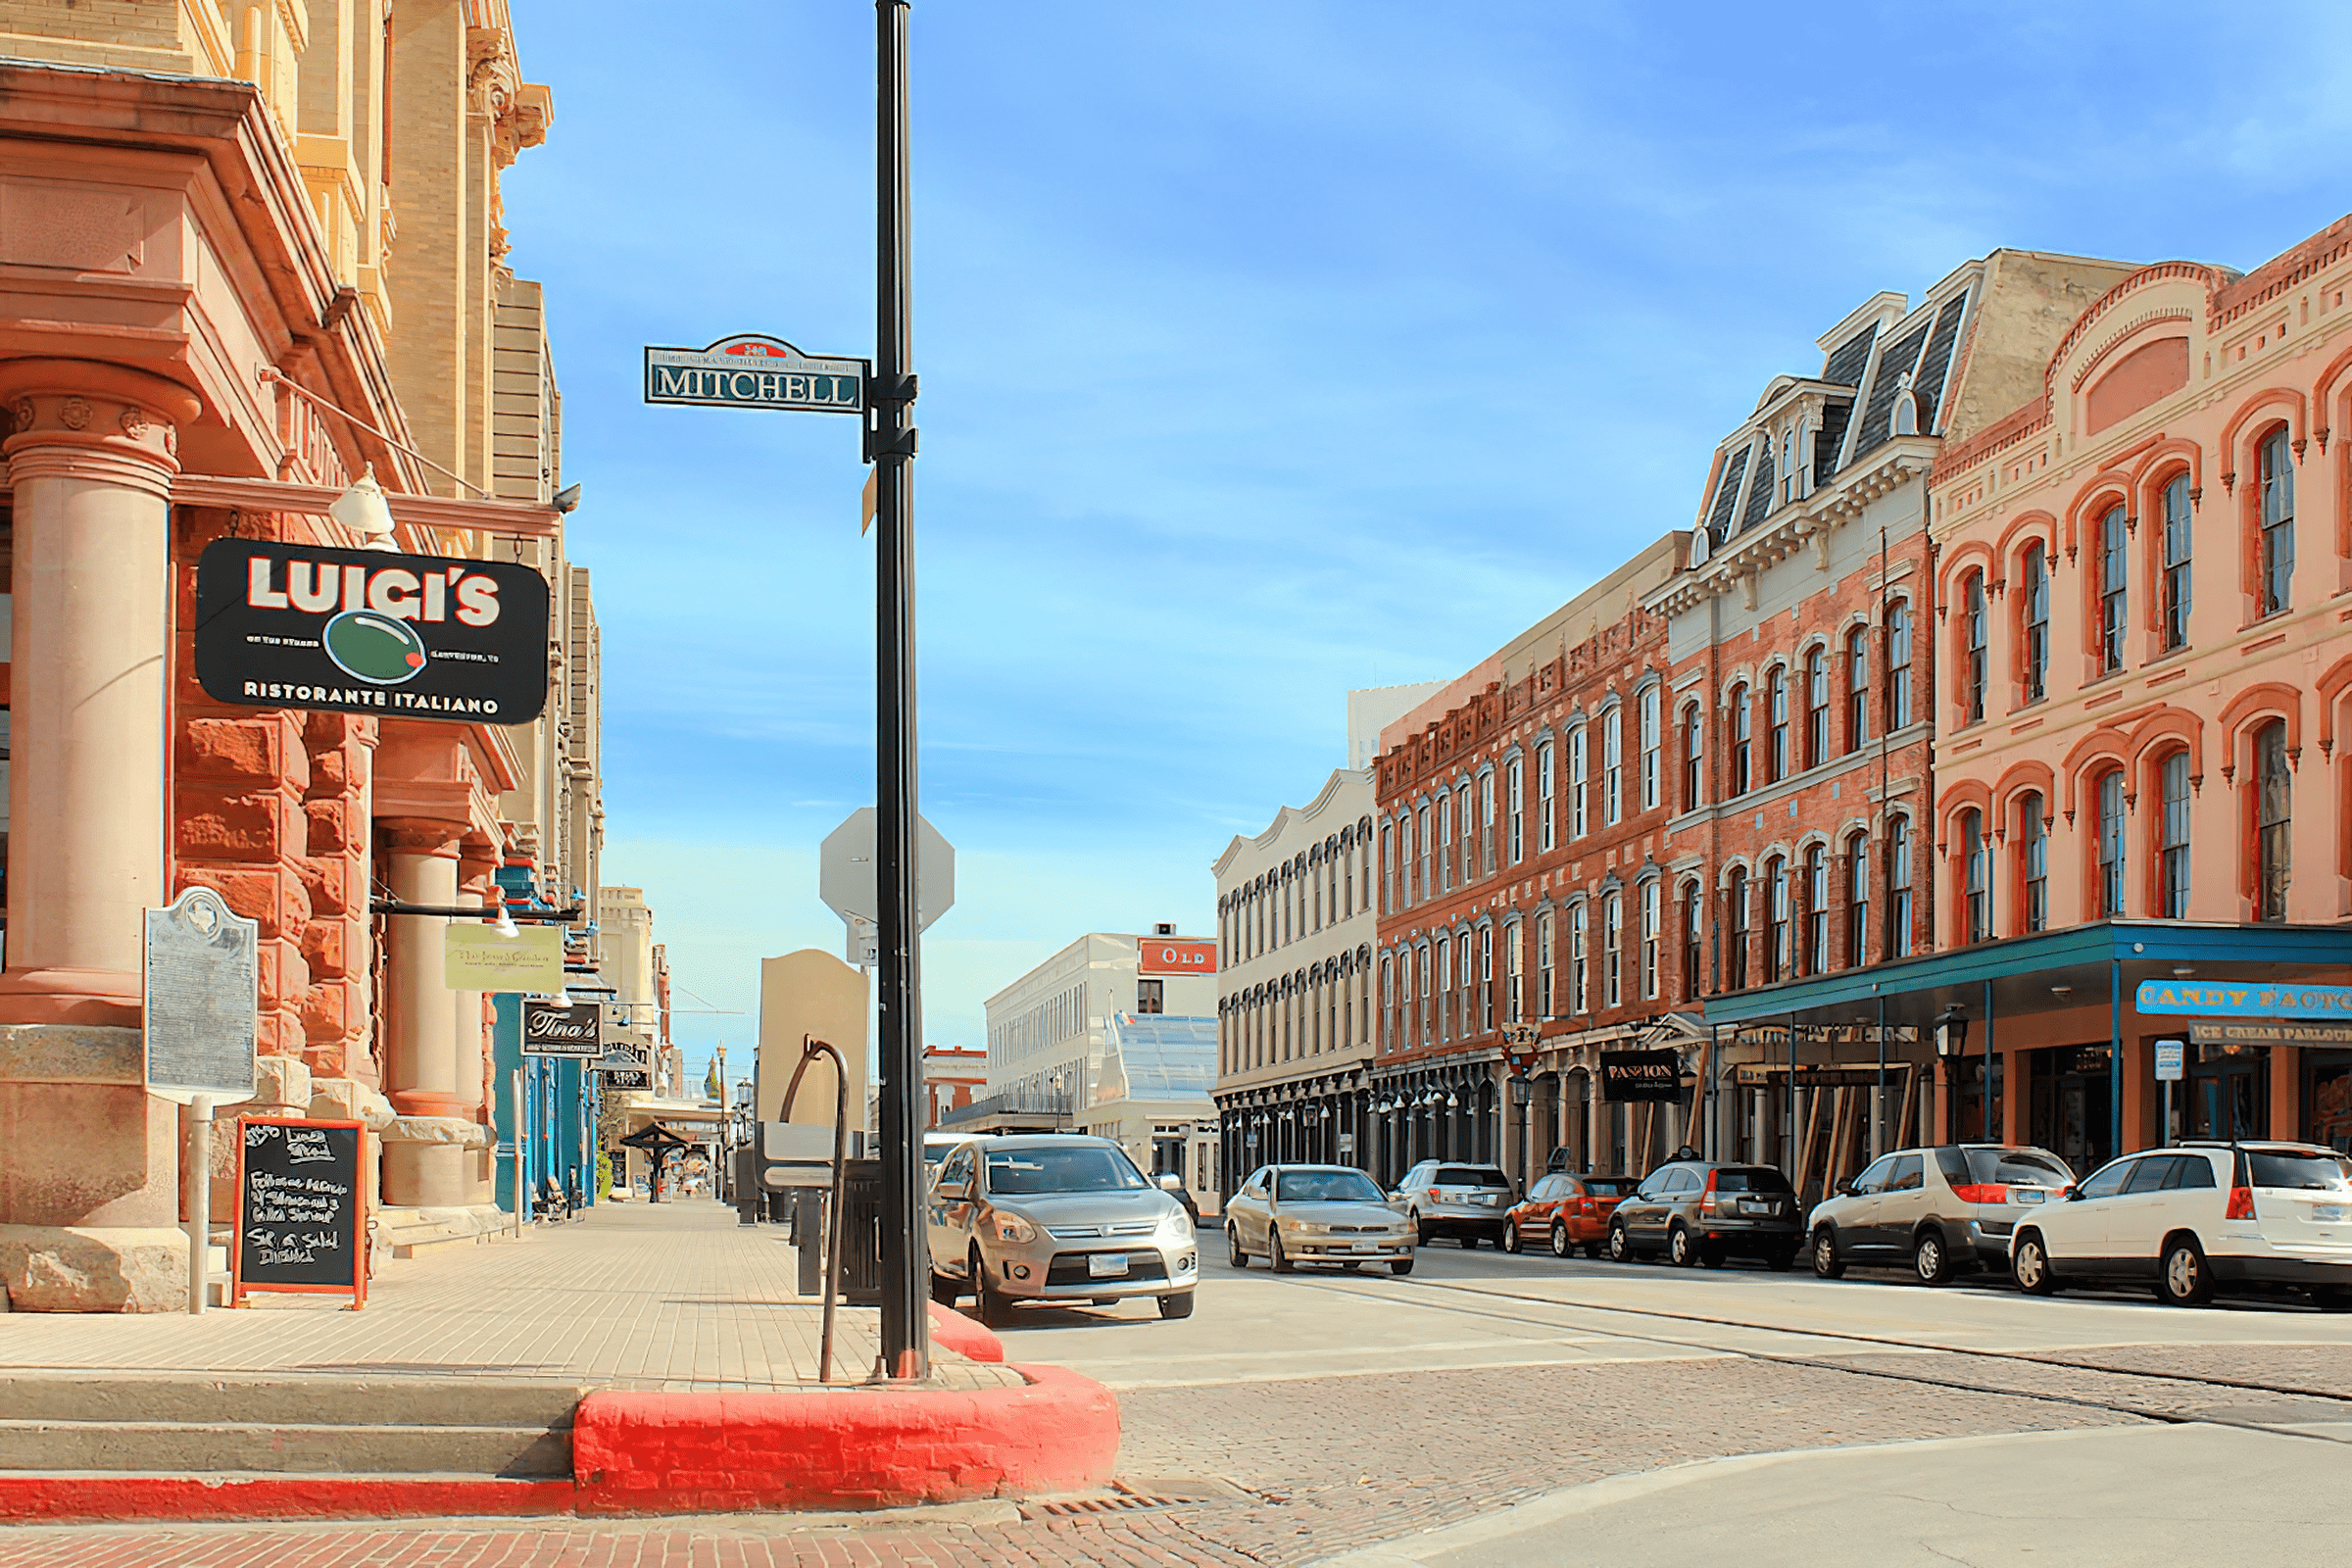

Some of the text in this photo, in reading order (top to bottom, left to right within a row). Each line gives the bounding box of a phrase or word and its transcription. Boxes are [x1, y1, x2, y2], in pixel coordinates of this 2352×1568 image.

[657, 367, 856, 407] MITCHELL
[246, 556, 501, 627] LUIGI'S
[244, 681, 499, 715] RISTORANTE ITALIANO
[2139, 986, 2247, 1007] CANDY
[527, 1008, 598, 1039] Tina's
[2193, 1025, 2222, 1039] ICE
[2226, 1026, 2281, 1040] CREAM
